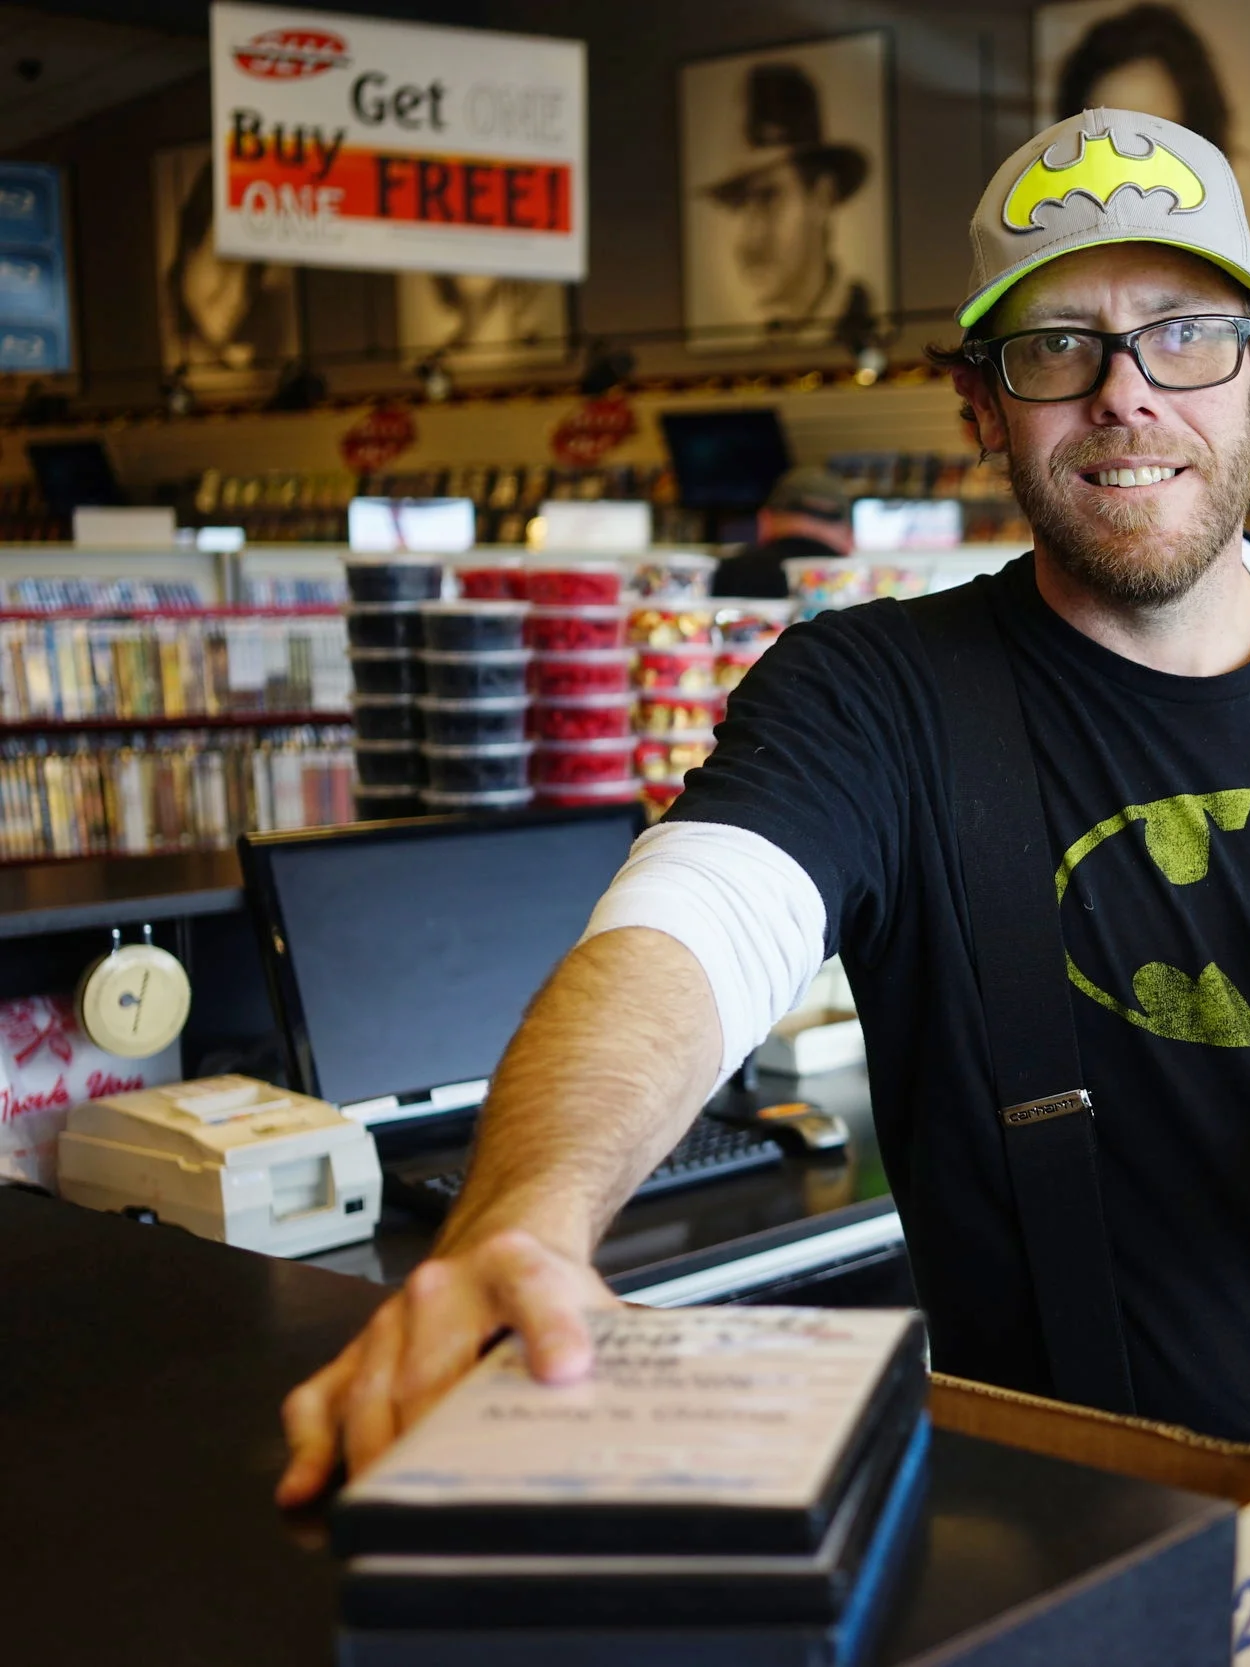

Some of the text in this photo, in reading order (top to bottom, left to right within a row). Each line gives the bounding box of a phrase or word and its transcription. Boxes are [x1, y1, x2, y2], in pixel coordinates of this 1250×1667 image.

[229, 107, 348, 182] Buy
[350, 69, 569, 146] Get ONE
[239, 153, 563, 243] ONE FREE!
